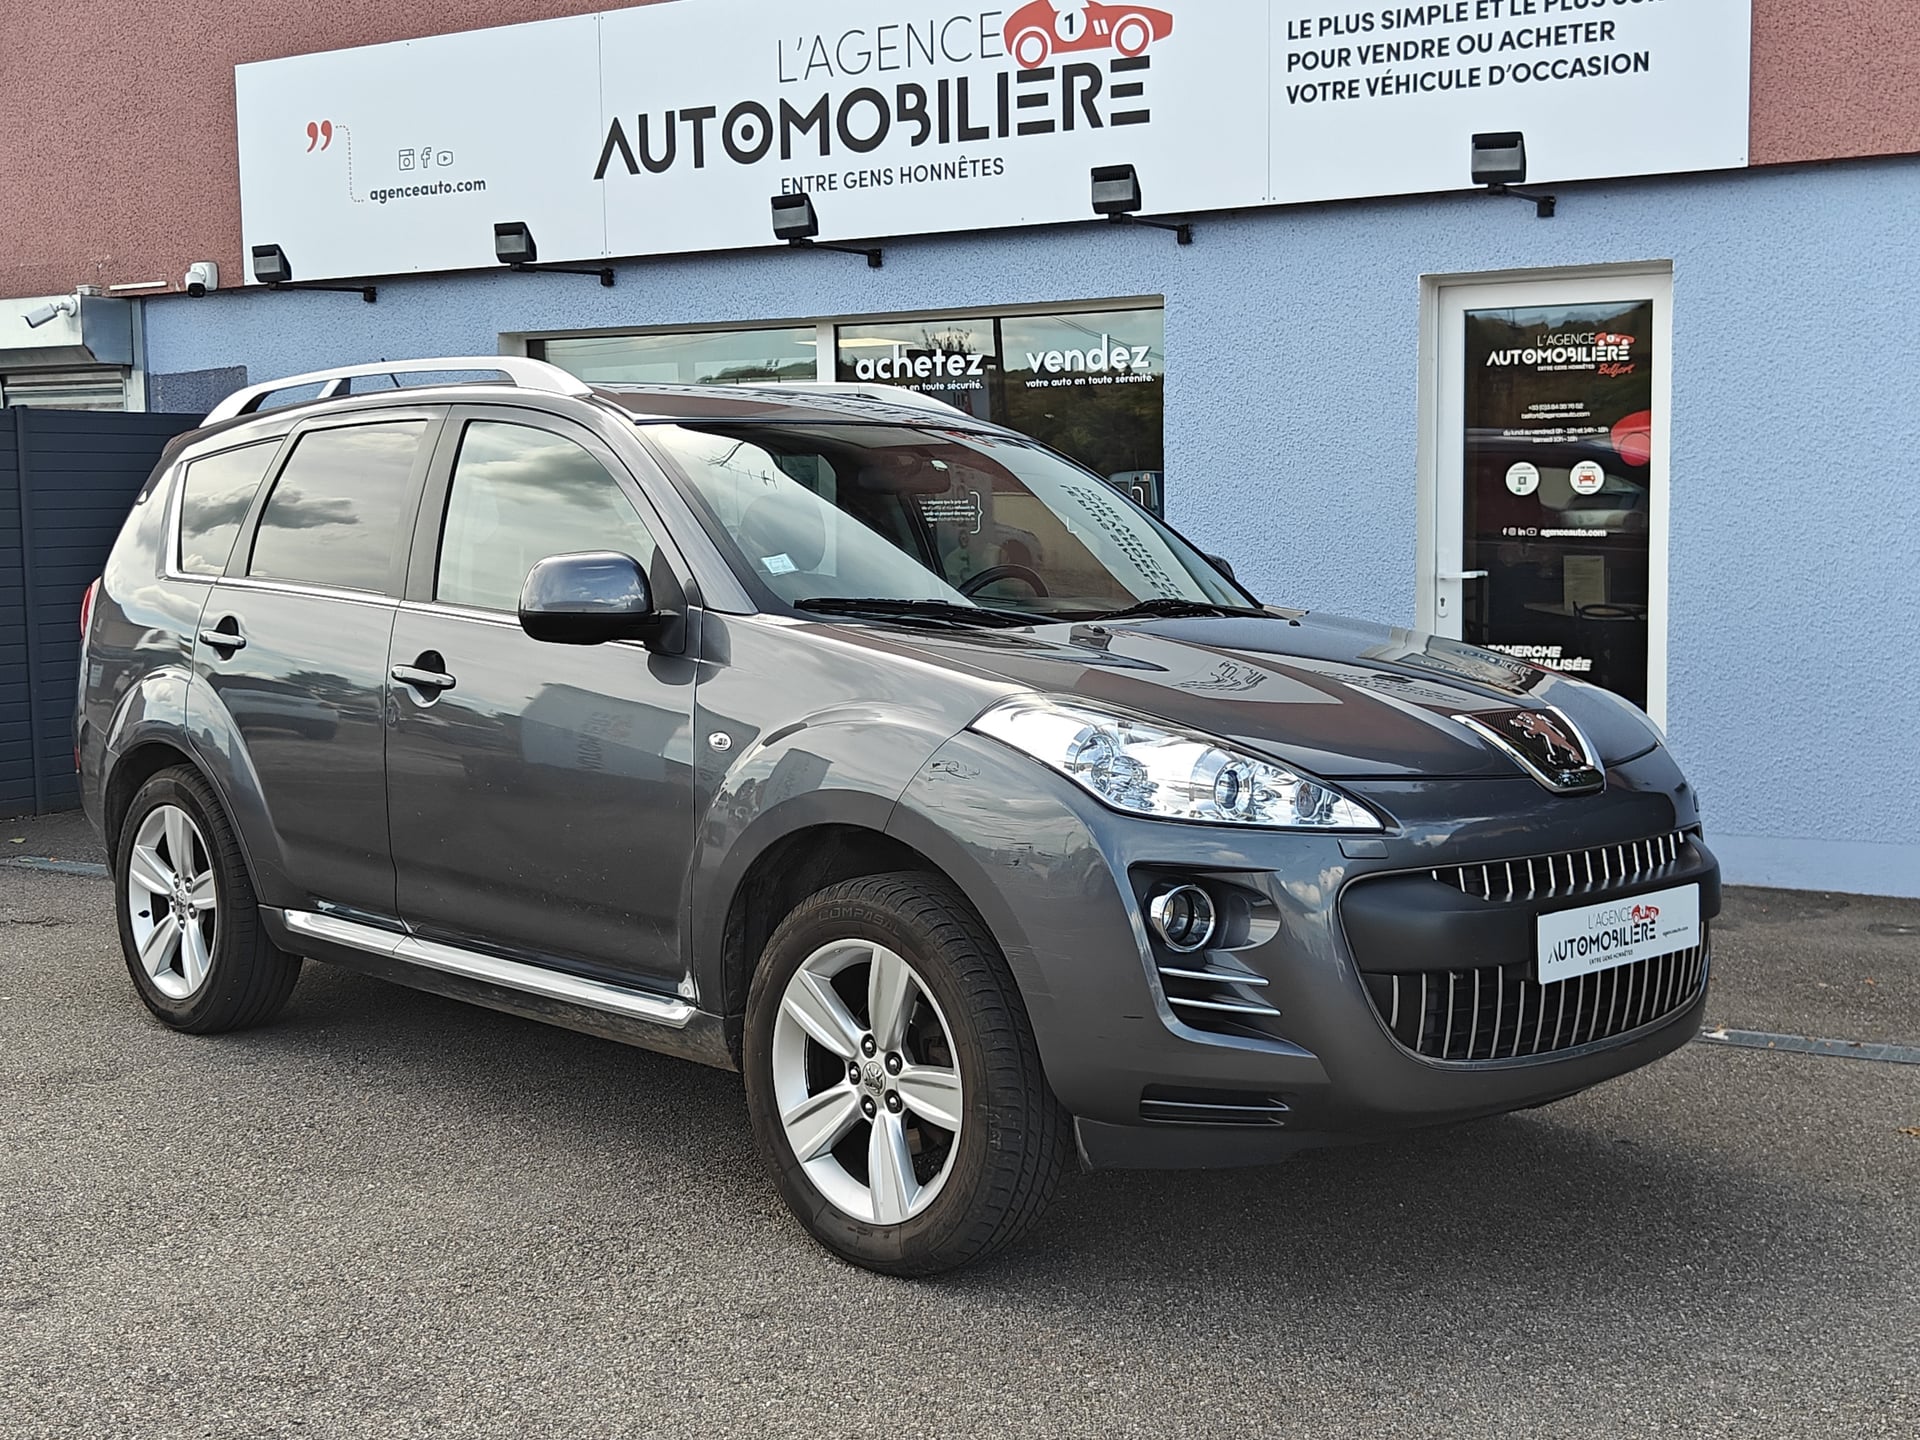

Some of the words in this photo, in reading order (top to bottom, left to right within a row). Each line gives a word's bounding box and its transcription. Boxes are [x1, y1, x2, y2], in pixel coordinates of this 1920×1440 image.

[1287, 19, 1312, 40] LE
[1318, 12, 1375, 37] PLUS
[1381, 1, 1469, 31] SIMPLE
[1475, 0, 1501, 20] ET
[1510, 0, 1537, 16] LE
[777, 11, 1004, 83] L'AGENCE
[1287, 47, 1352, 73] POUR
[1357, 36, 1451, 65] VENDRE
[1456, 32, 1493, 55] OU
[1499, 20, 1616, 51] ACHETER
[1286, 78, 1361, 105] VOTRE
[1366, 68, 1481, 97] VÉHICULE
[1488, 51, 1651, 86] D'OCCASION
[369, 179, 488, 205] agenceauto.com
[781, 173, 838, 195] ENTRE
[843, 167, 894, 190] GENS
[900, 155, 1005, 185] HONNÊTES
[1025, 333, 1151, 374] vendez
[1537, 332, 1596, 347] L'AGENCE
[855, 343, 984, 380] achetez
[1597, 363, 1635, 378] Belfort
[922, 381, 945, 391] toute
[947, 379, 984, 390] sécurité.
[1025, 379, 1049, 389] votre
[1051, 377, 1072, 387] auto
[1074, 378, 1086, 386] en
[1088, 375, 1113, 385] toute
[1115, 372, 1155, 384] sérénité.
[1588, 906, 1632, 930] L'AGENCE
